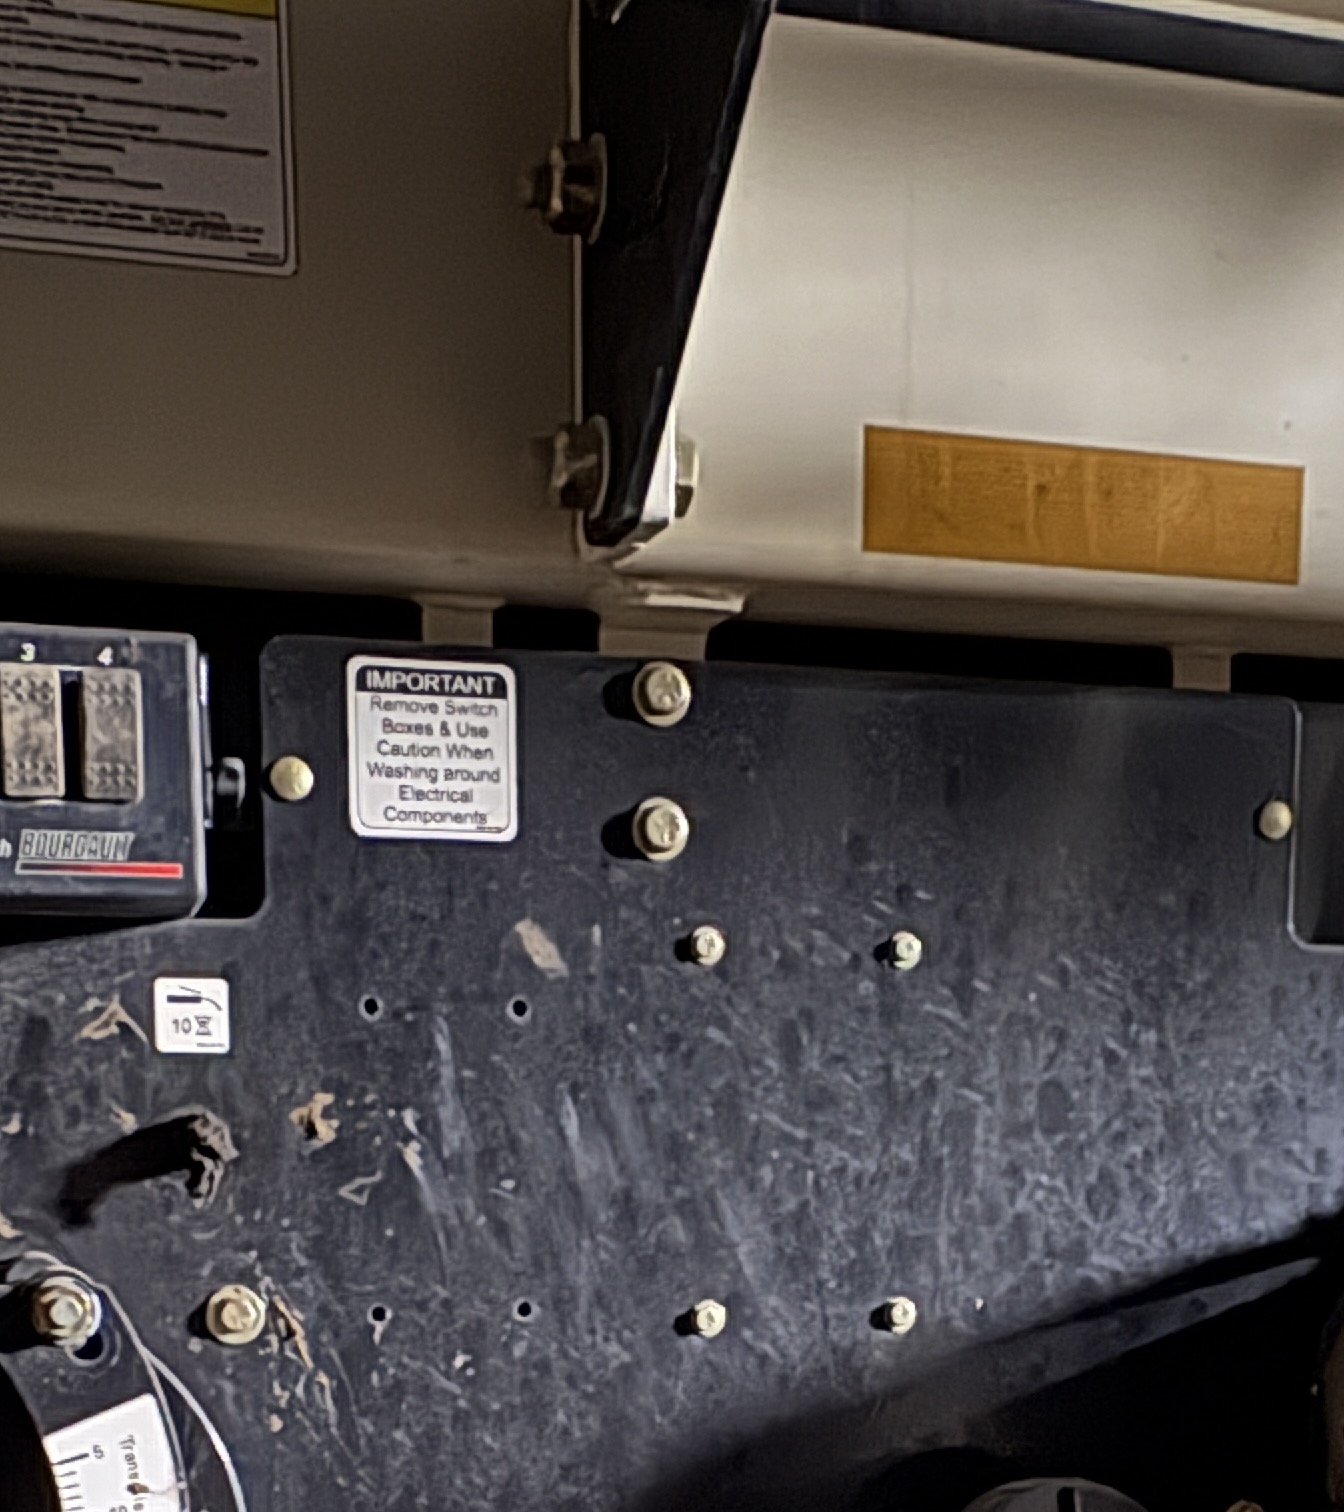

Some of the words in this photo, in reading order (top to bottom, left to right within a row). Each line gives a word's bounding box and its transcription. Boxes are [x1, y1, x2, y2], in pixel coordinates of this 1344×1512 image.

[20, 642, 37, 663] 3
[97, 646, 114, 666] 4
[365, 669, 497, 695] IMPORTANT
[370, 696, 439, 716] Remove
[445, 701, 498, 718] Switch
[382, 717, 434, 736] Boxes
[440, 720, 452, 737] &
[456, 722, 490, 739] Use
[376, 739, 441, 759] Caution
[445, 742, 494, 761] When
[366, 761, 439, 784] Washing
[443, 766, 501, 784] around
[398, 784, 474, 804] Electrical
[383, 805, 488, 826] Components
[171, 1016, 192, 1035] 10
[92, 1444, 105, 1460] 5
